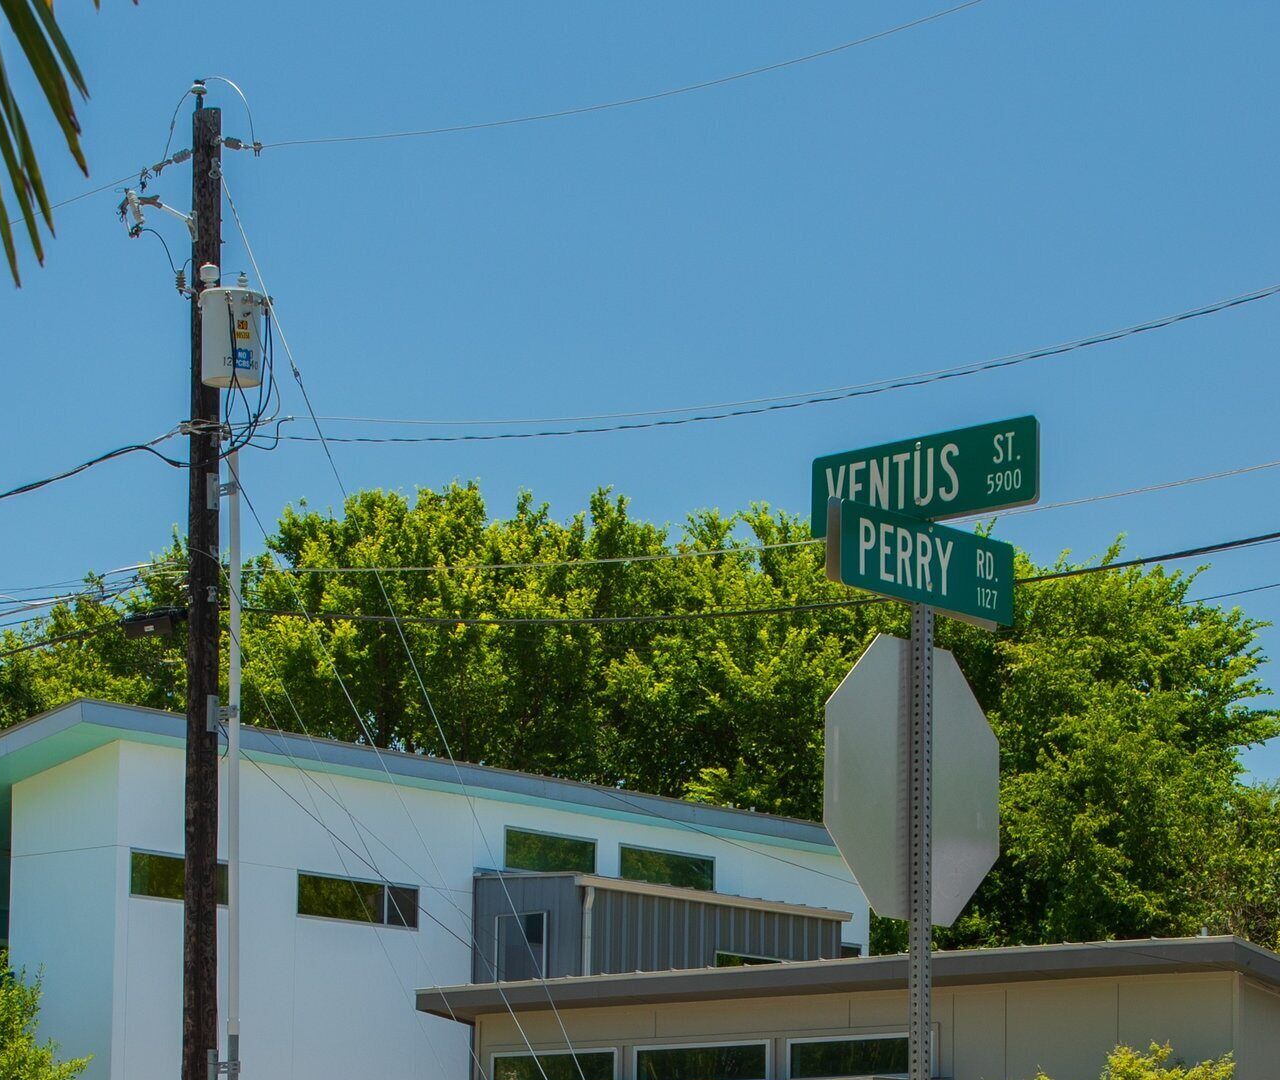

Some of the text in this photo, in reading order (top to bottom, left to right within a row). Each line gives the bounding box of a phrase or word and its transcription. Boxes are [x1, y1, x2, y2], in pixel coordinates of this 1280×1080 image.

[238, 351, 246, 359] NO
[826, 431, 1021, 511] VENTUS ST.
[987, 468, 1022, 495] 5900
[859, 517, 999, 596] PERRY RD.
[977, 587, 998, 610] 1127
